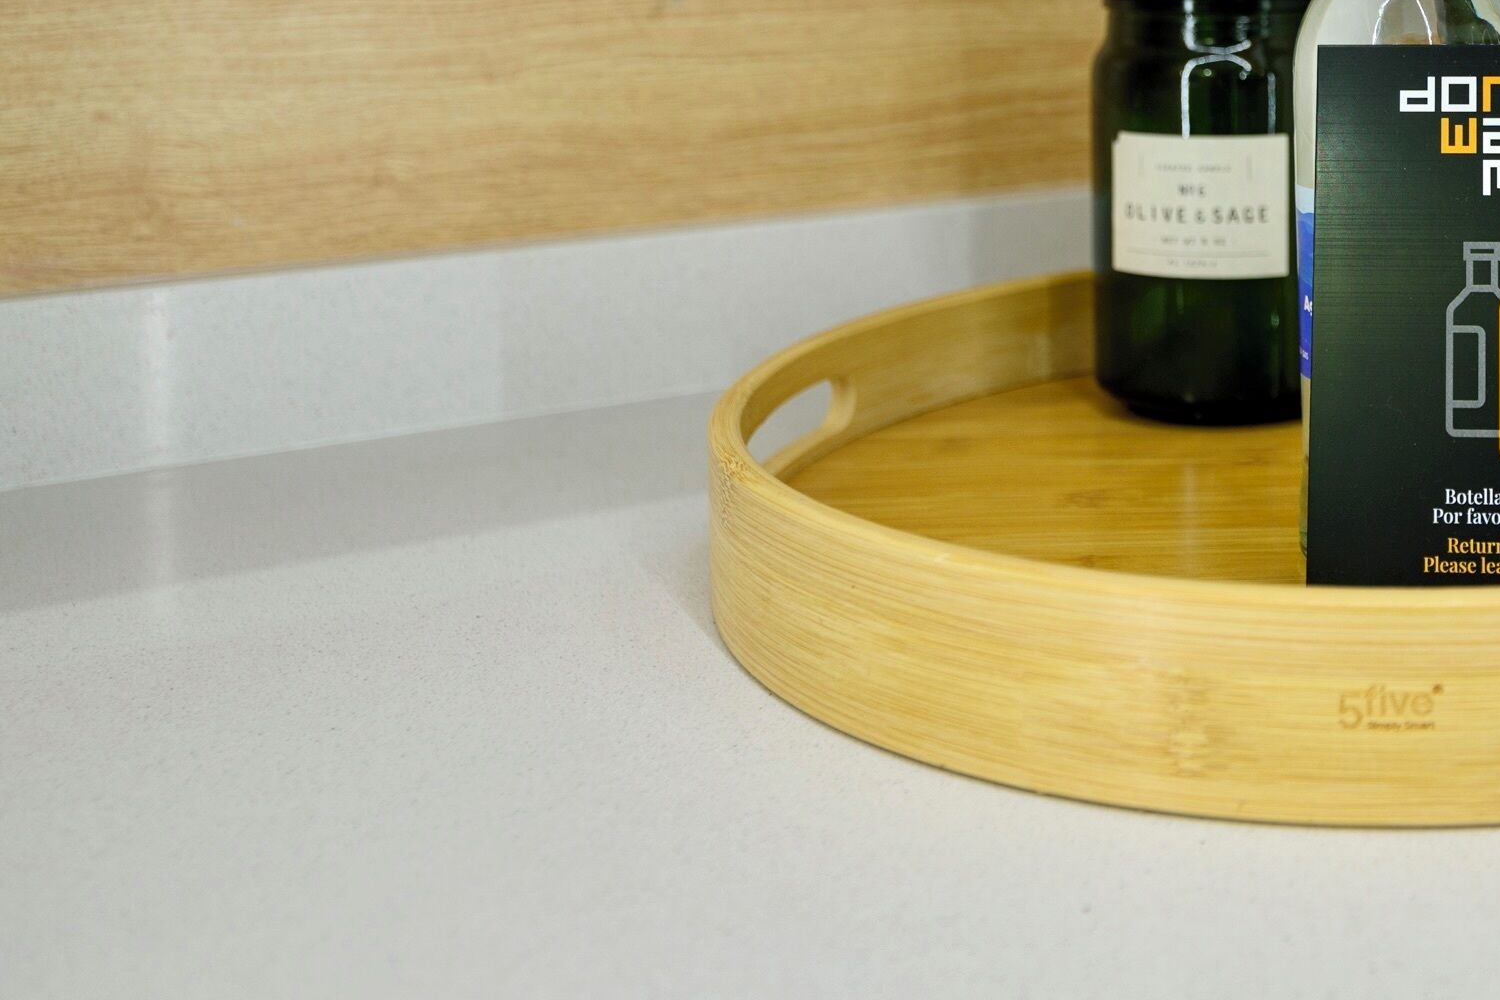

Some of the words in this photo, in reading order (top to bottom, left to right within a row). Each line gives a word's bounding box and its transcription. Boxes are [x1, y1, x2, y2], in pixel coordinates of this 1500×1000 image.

[1124, 202, 1187, 225] OLIVE
[1211, 205, 1271, 225] SAGE
[1432, 508, 1463, 525] Por
[1423, 556, 1477, 574] Please
